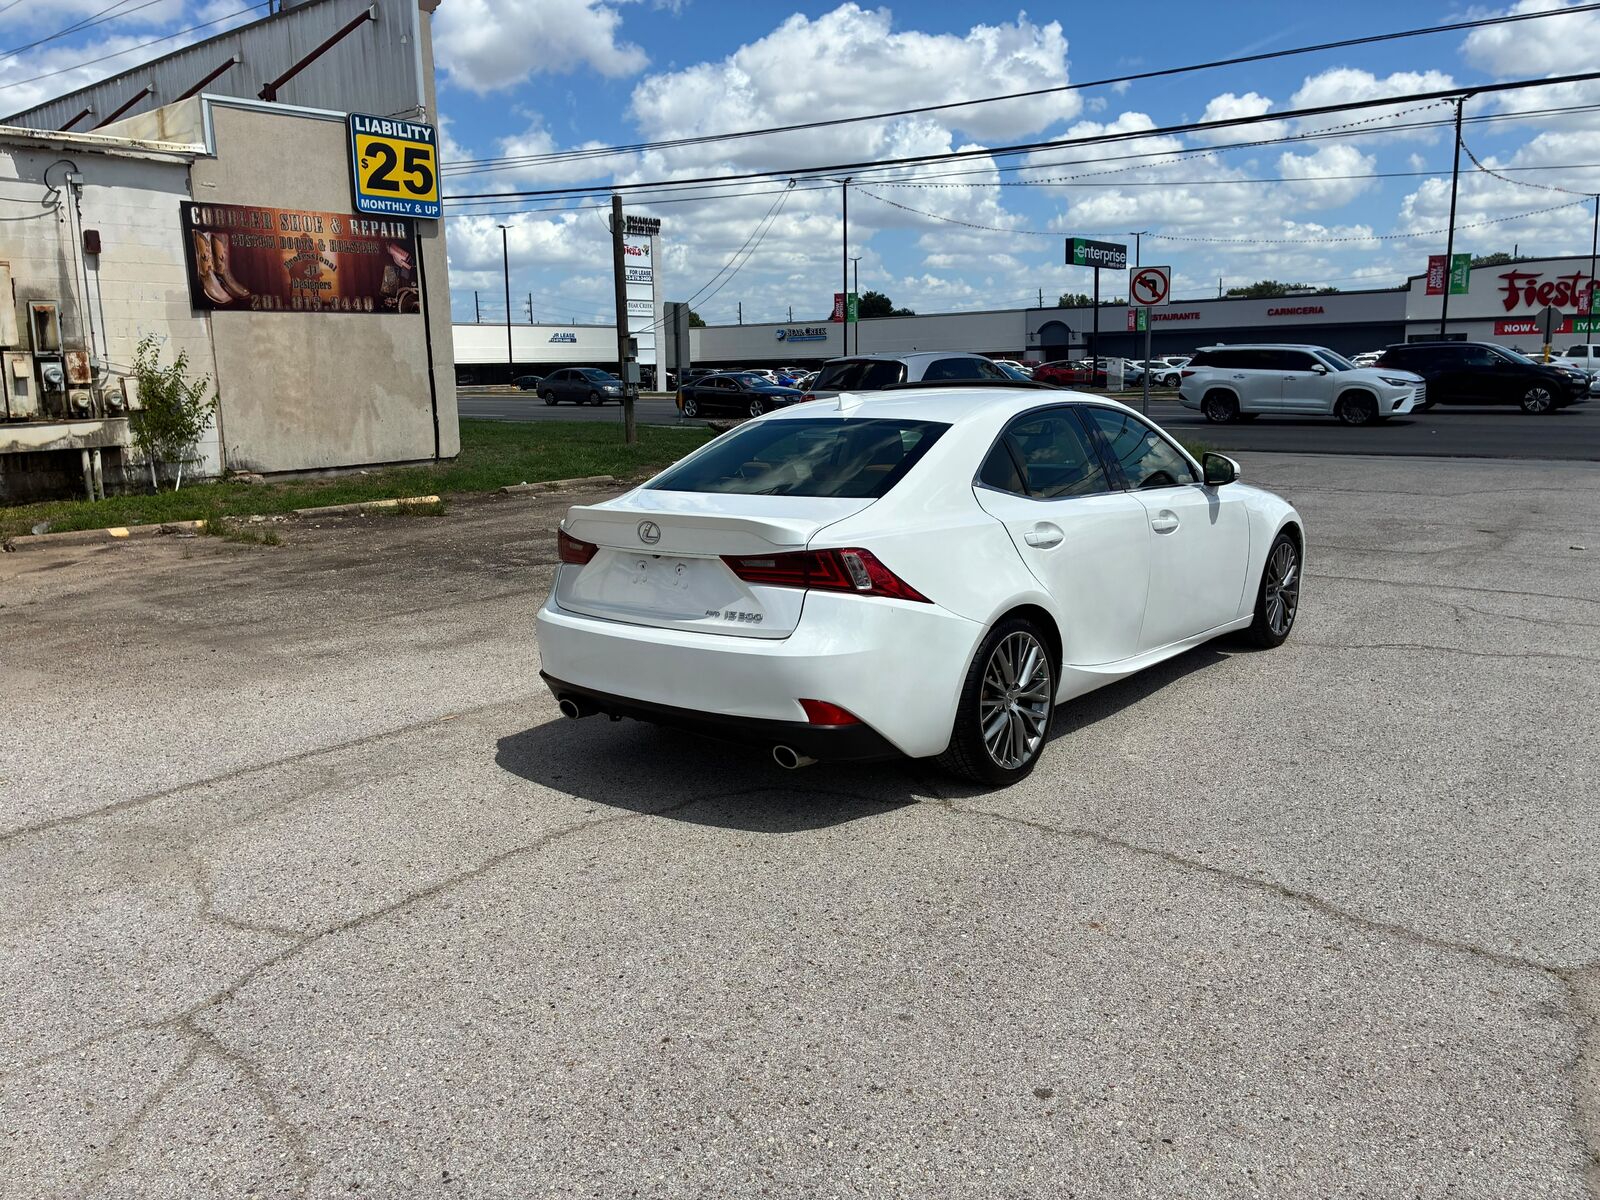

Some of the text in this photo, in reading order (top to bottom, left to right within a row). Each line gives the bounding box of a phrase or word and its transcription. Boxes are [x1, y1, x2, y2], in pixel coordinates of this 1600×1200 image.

[355, 116, 432, 141] LIABILITY
[360, 199, 438, 215] MONTHLY & UP
[190, 206, 407, 239] COBBLER SHOE & REPAIR
[284, 252, 338, 273] Professional
[1077, 244, 1126, 264] enterprise
[292, 279, 332, 292] Designers
[1267, 305, 1325, 316] CARNICERIA
[1504, 324, 1531, 332] NOW
